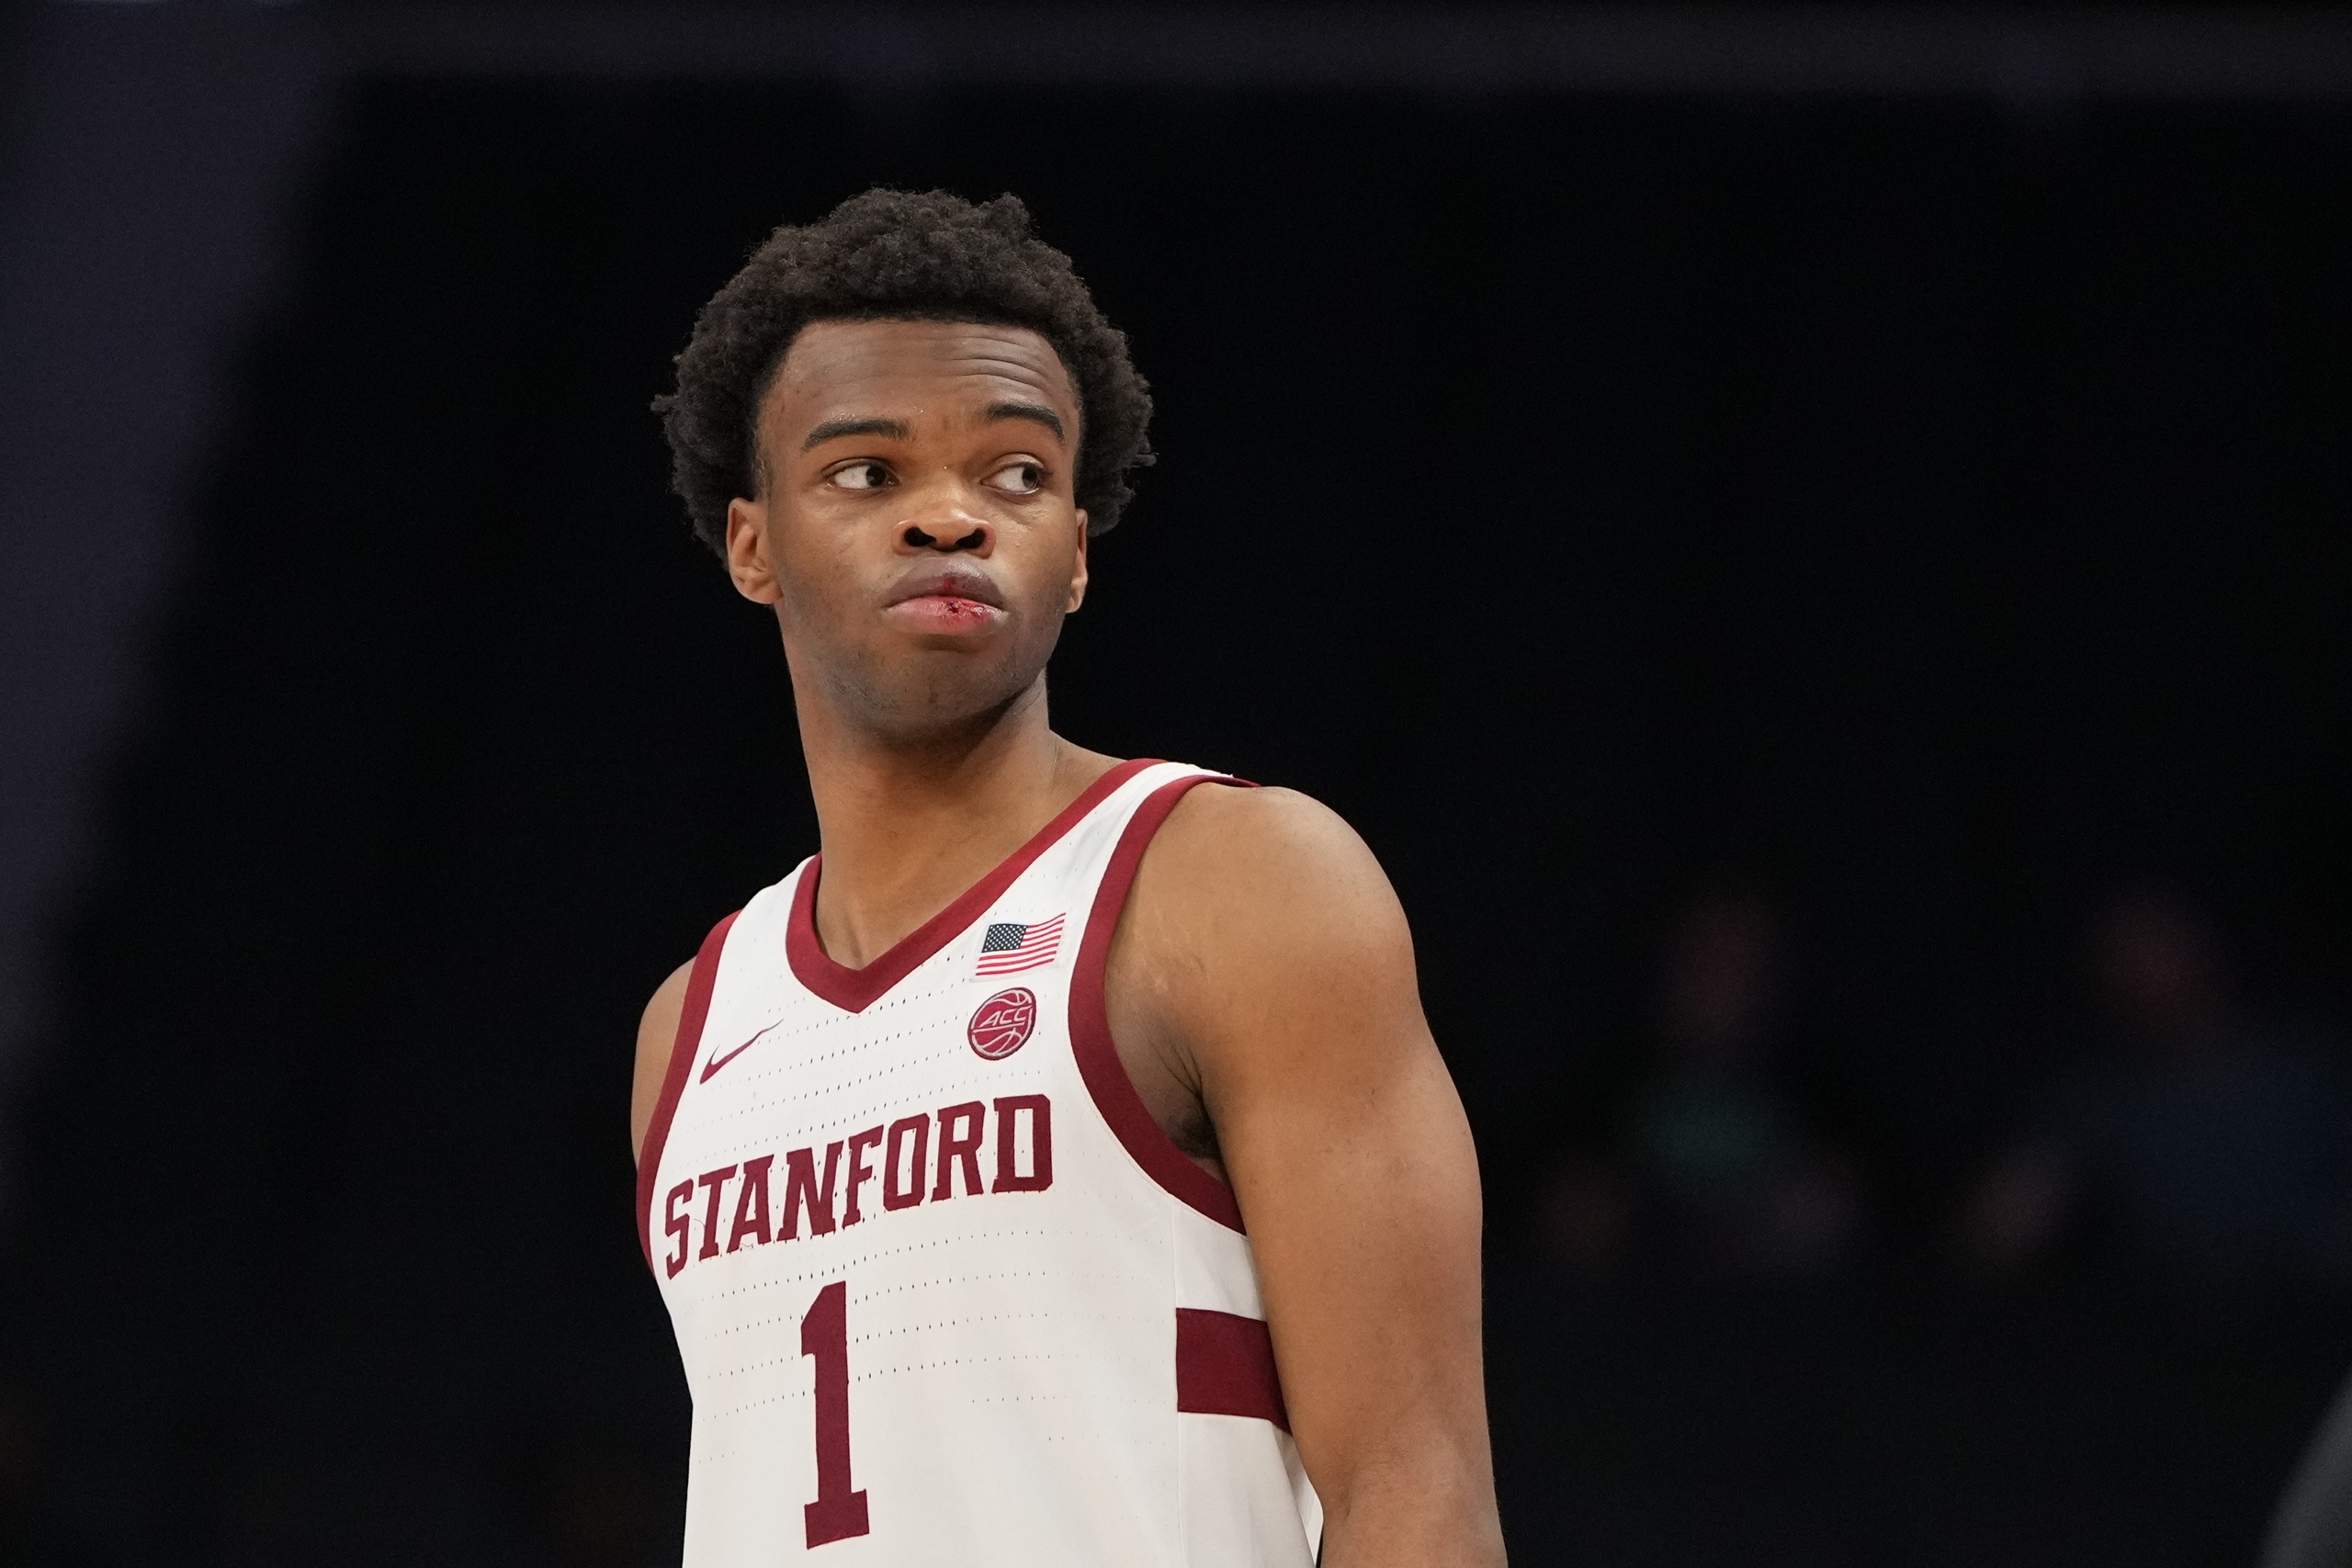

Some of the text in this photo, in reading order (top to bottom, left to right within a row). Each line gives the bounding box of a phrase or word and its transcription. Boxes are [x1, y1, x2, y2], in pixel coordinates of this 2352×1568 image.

[979, 1005, 1033, 1028] ACC
[664, 1094, 1054, 1280] STANFORD
[801, 1280, 870, 1550] 1
